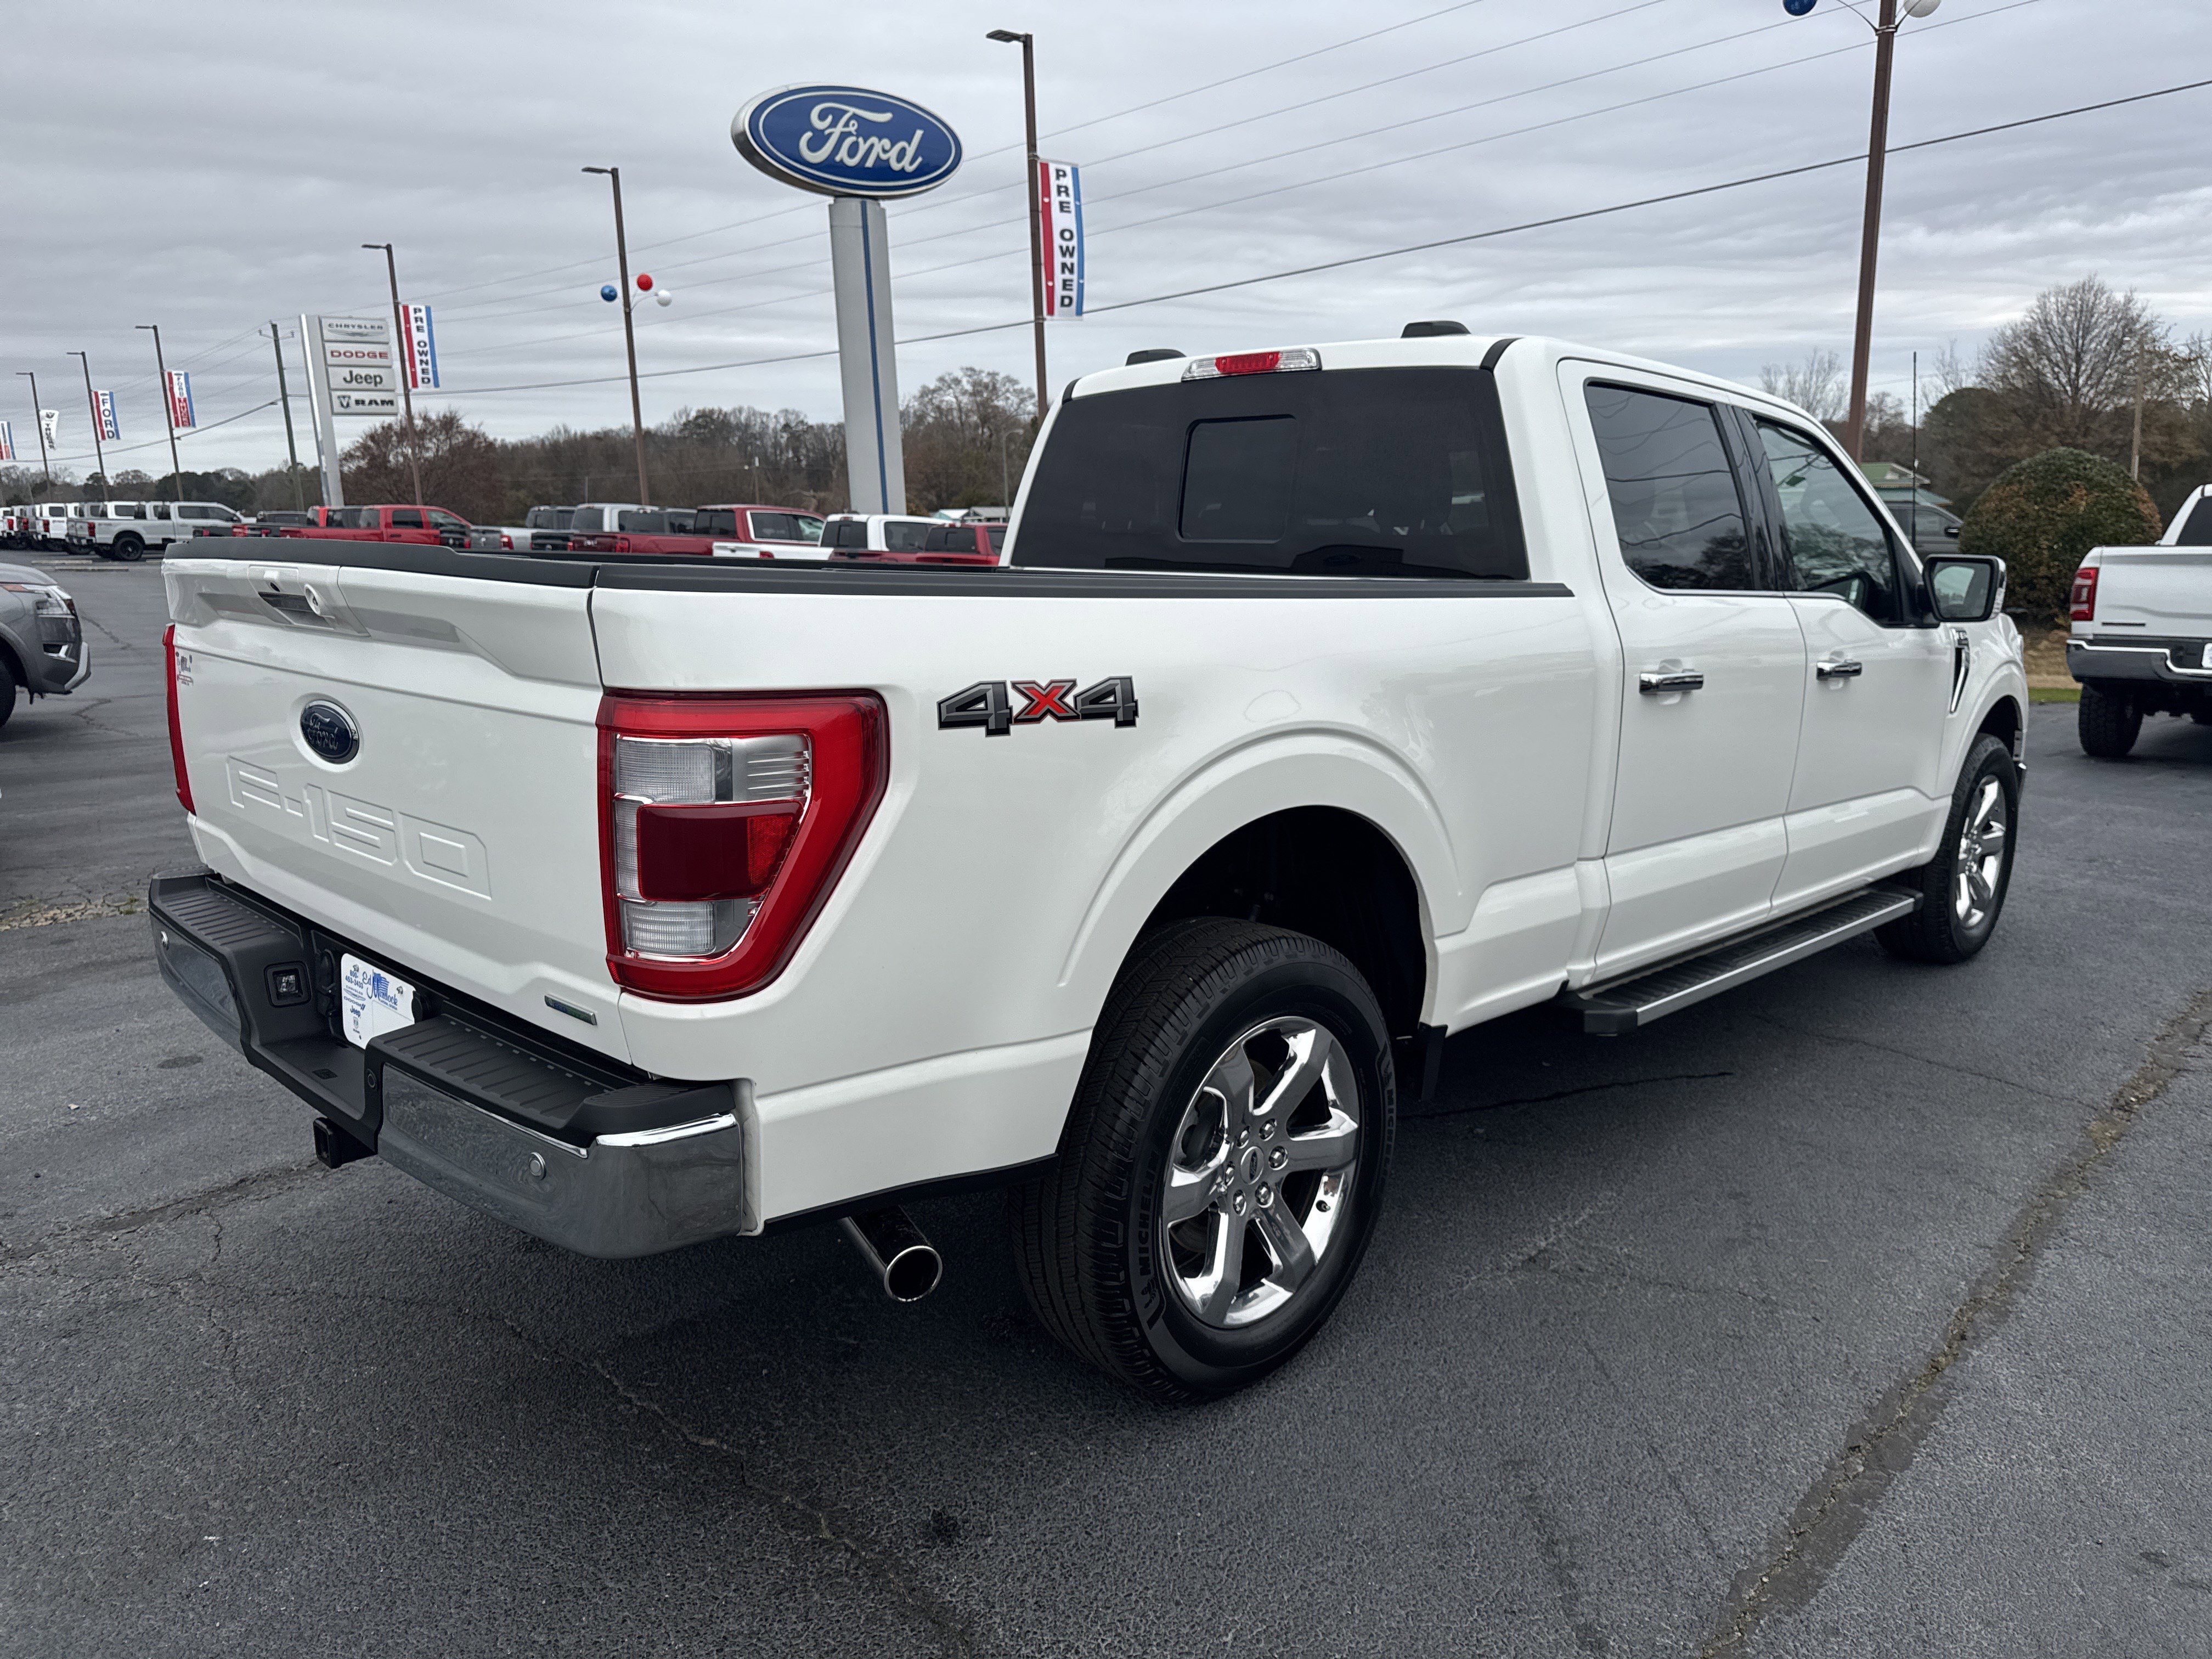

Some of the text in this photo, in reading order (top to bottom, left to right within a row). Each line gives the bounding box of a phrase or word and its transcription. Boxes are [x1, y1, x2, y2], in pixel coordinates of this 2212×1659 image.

[799, 102, 924, 173] Ford
[1055, 168, 1075, 308] PRE OWNED
[330, 349, 388, 359] DODGE
[342, 370, 383, 387] Jeep
[413, 307, 431, 385] PRE OWNED
[101, 398, 115, 439] FORD
[308, 713, 338, 751] Ford
[225, 755, 492, 900] F-150
[1137, 1149, 1159, 1276] MICHELIN
